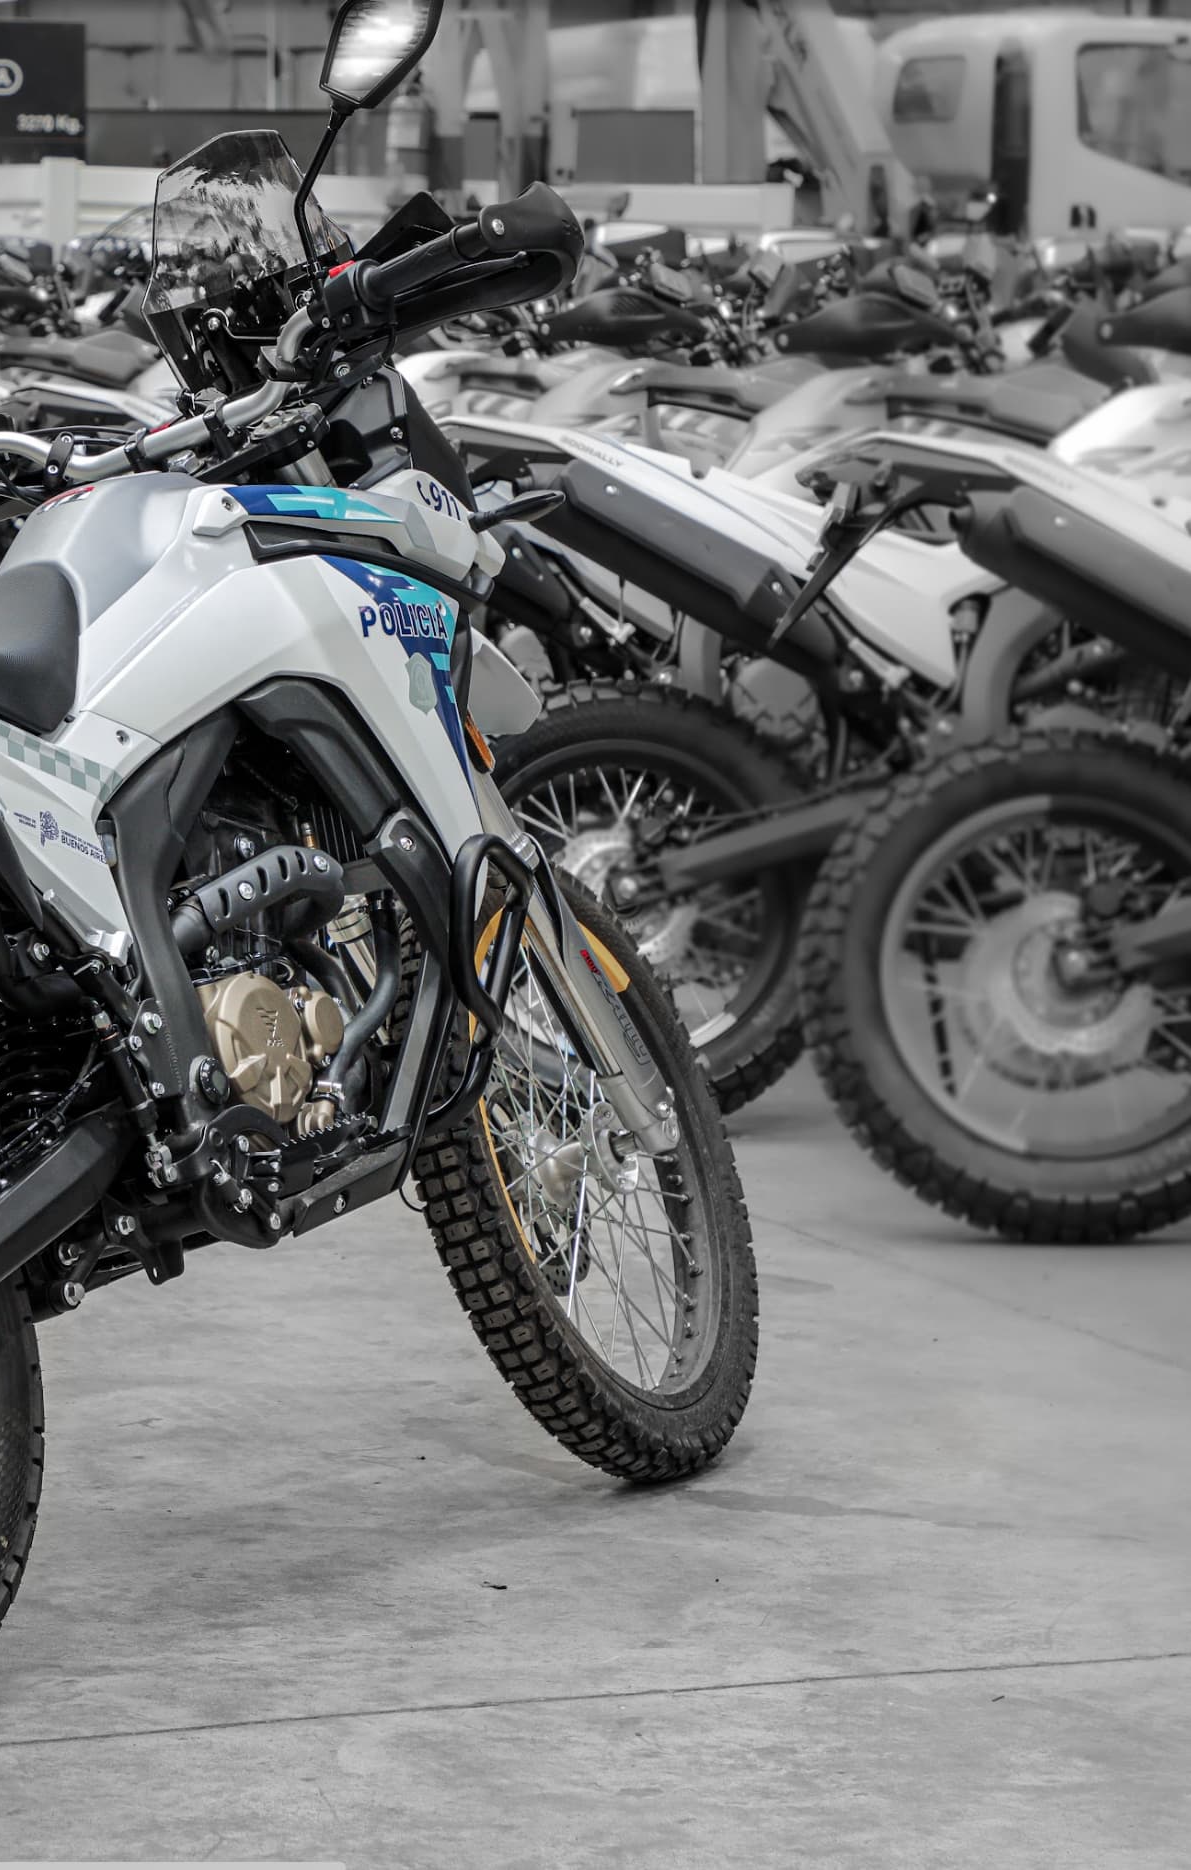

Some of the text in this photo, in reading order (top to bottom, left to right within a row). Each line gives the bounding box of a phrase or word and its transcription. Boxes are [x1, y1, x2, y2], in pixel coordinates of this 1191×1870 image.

[432, 481, 462, 521] 911
[358, 602, 450, 640] POLICIA
[61, 834, 90, 856] BUENOS
[90, 849, 107, 864] AIRE
